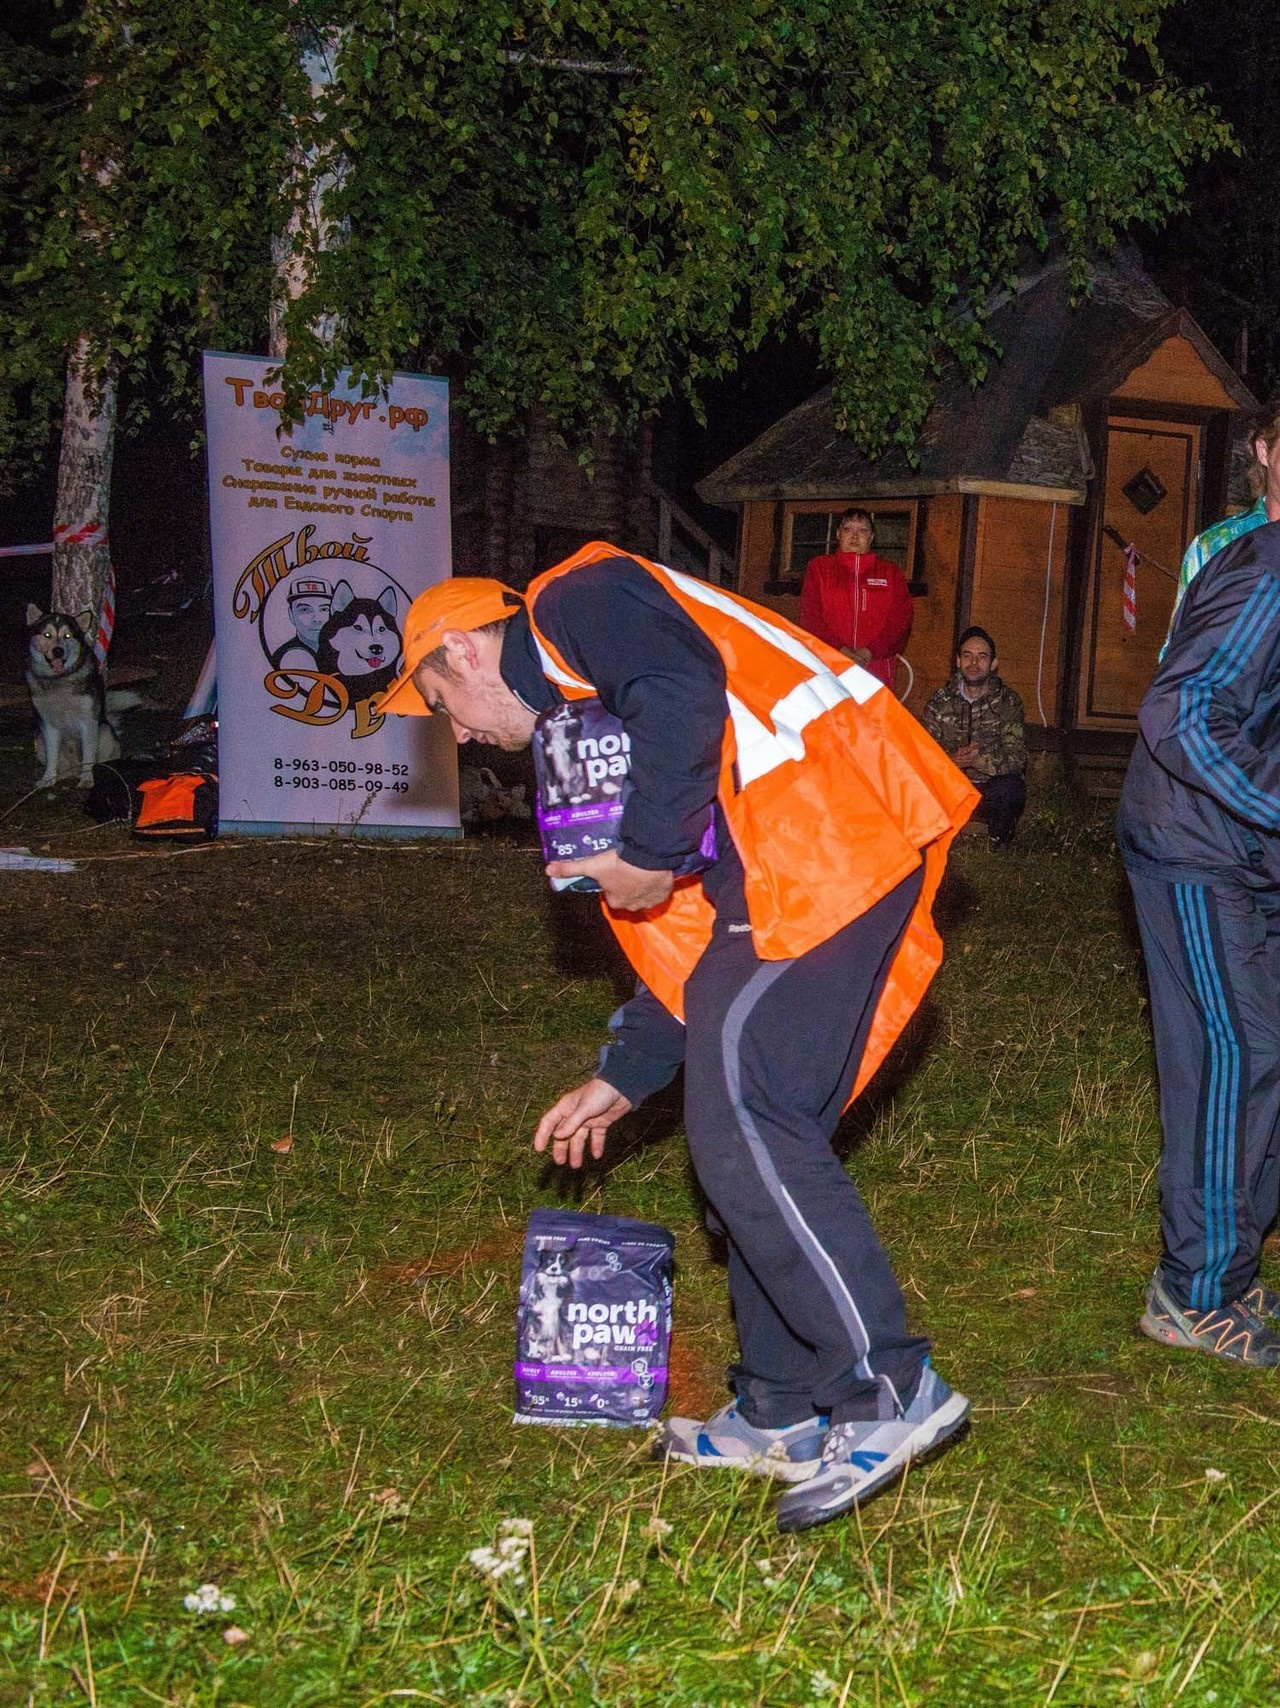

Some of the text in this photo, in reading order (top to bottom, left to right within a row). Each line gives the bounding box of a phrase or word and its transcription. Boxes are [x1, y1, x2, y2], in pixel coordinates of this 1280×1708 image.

[280, 445, 381, 469] Сухие корма
[241, 458, 417, 488] Товары для животных
[222, 474, 436, 507] Снаряжение ручной работы
[247, 495, 414, 523] для Ездового Спорта
[273, 757, 410, 777] 8-963-050-98-52
[585, 753, 632, 788] pa
[273, 774, 410, 794] 8-903-085-09-49
[567, 1299, 658, 1324] north
[572, 1322, 637, 1350] paw
